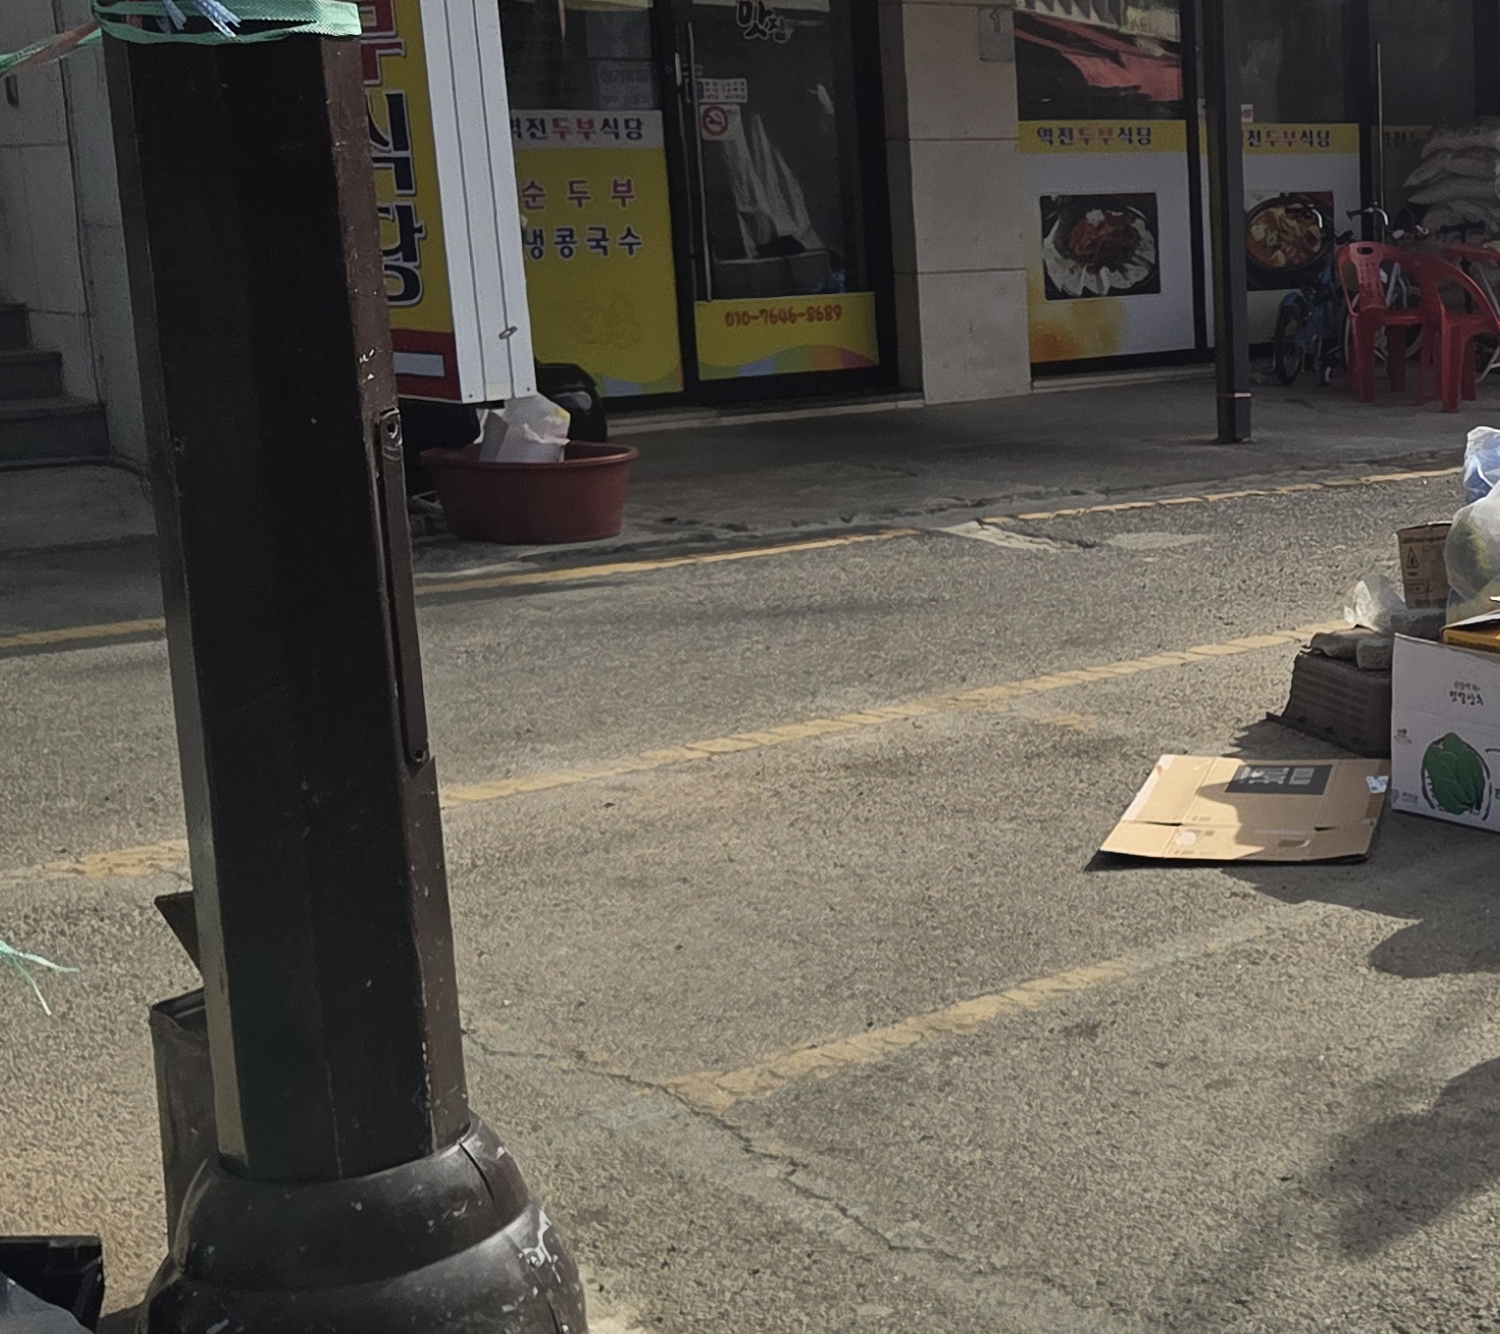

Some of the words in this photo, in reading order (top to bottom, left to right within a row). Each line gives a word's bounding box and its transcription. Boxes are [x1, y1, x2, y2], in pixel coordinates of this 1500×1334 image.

[1036, 126, 1152, 146] 역전두부식당
[521, 178, 635, 210] 순두부
[524, 226, 642, 261] 냉콩국수
[725, 304, 843, 328] 010-7646-8689
